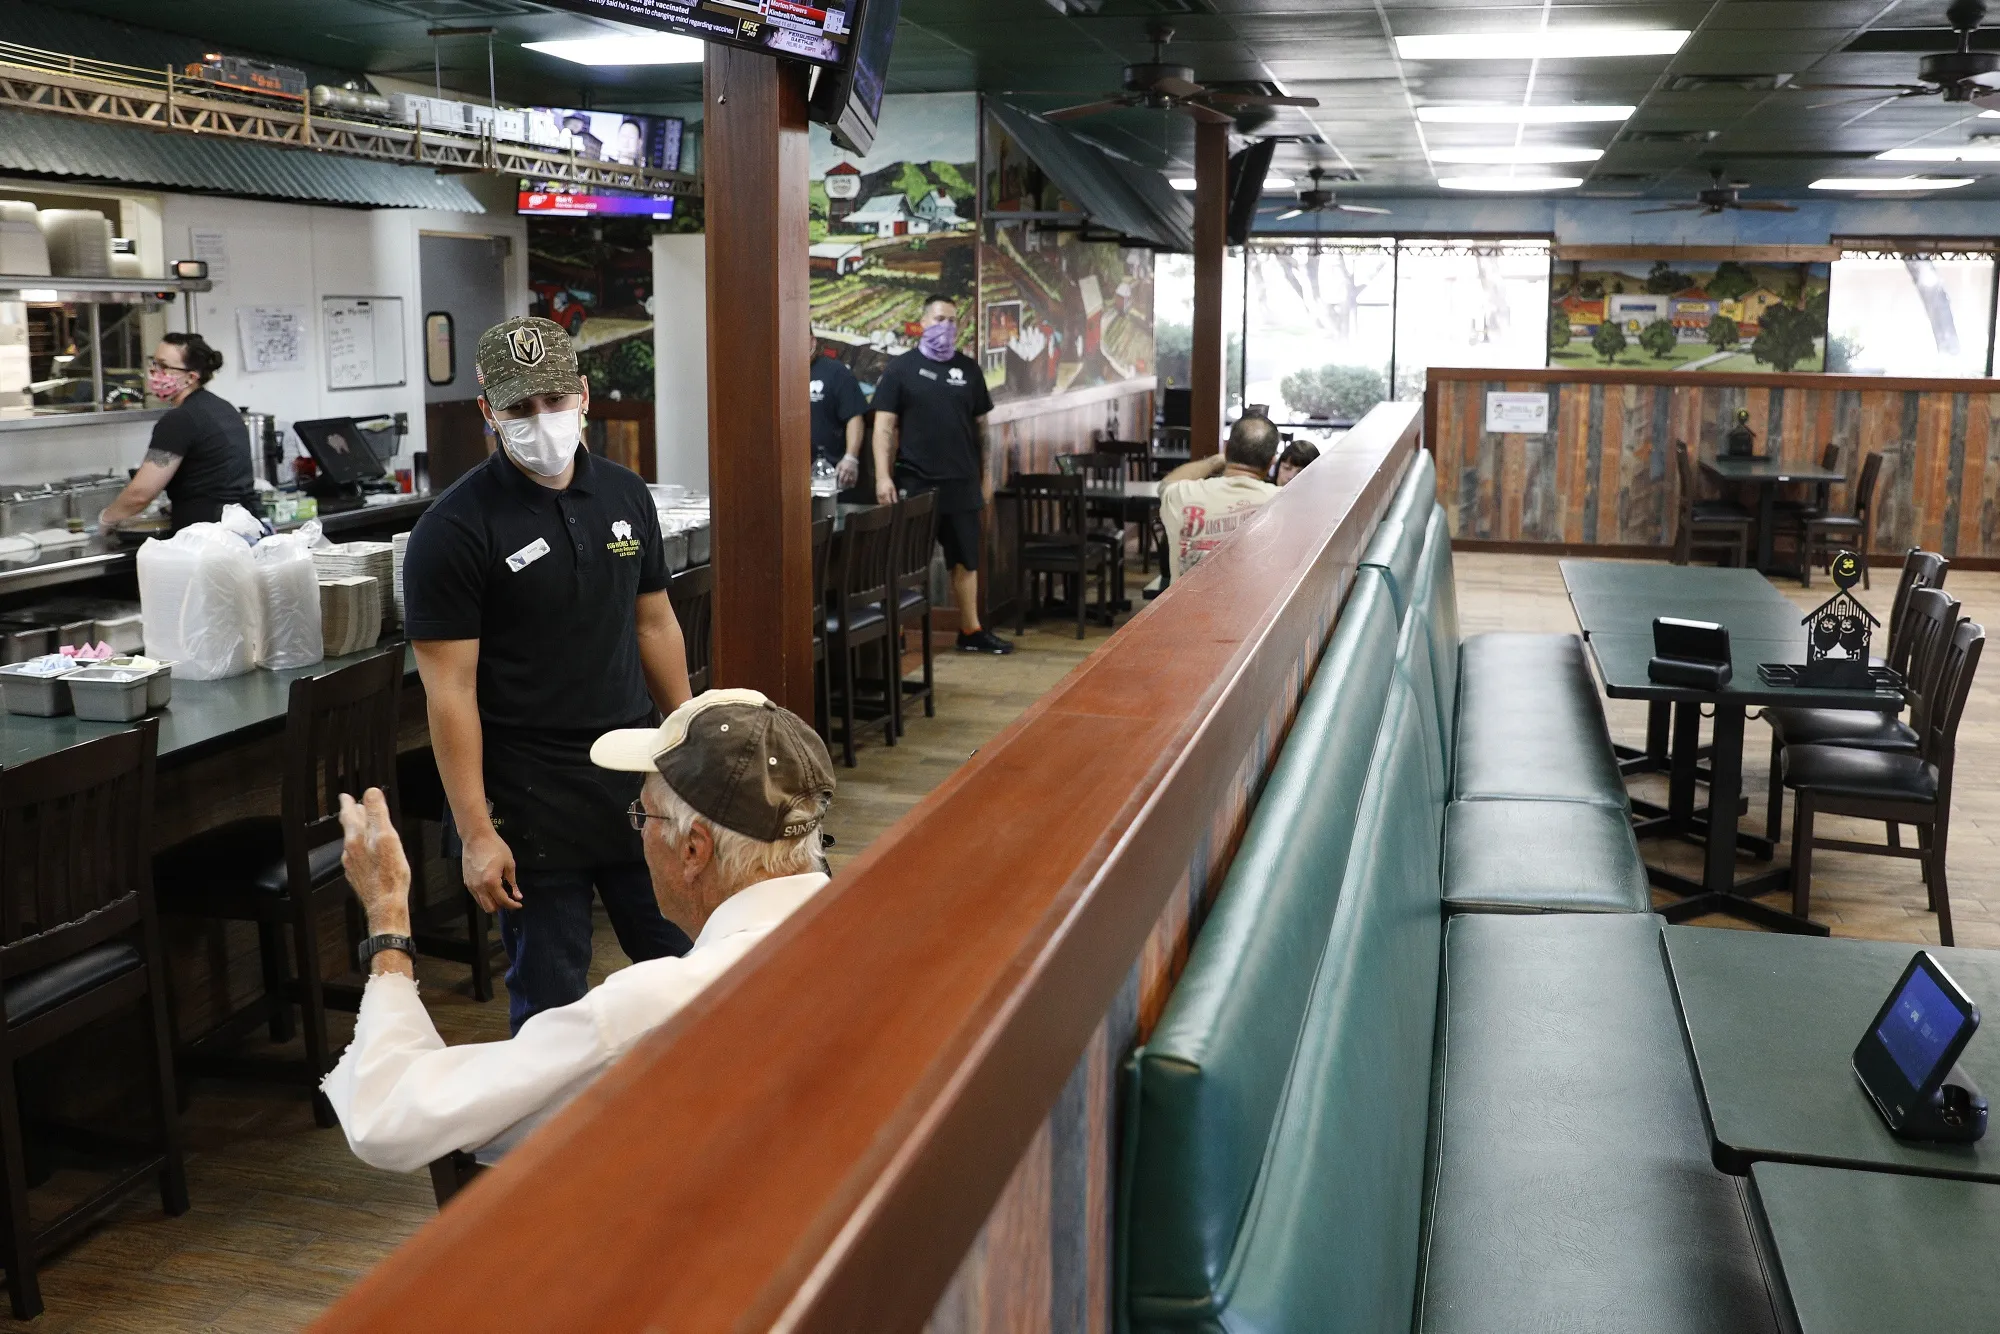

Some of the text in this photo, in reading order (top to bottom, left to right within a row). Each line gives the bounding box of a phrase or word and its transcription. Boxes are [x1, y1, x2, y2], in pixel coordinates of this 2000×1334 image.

[656, 0, 689, 14] vaccinated
[618, 2, 630, 10] he's
[650, 10, 676, 22] changing
[675, 16, 689, 24] mind
[689, 18, 713, 31] regarding
[713, 24, 734, 35] vaccines
[742, 20, 761, 32] UFC
[746, 30, 758, 38] 249
